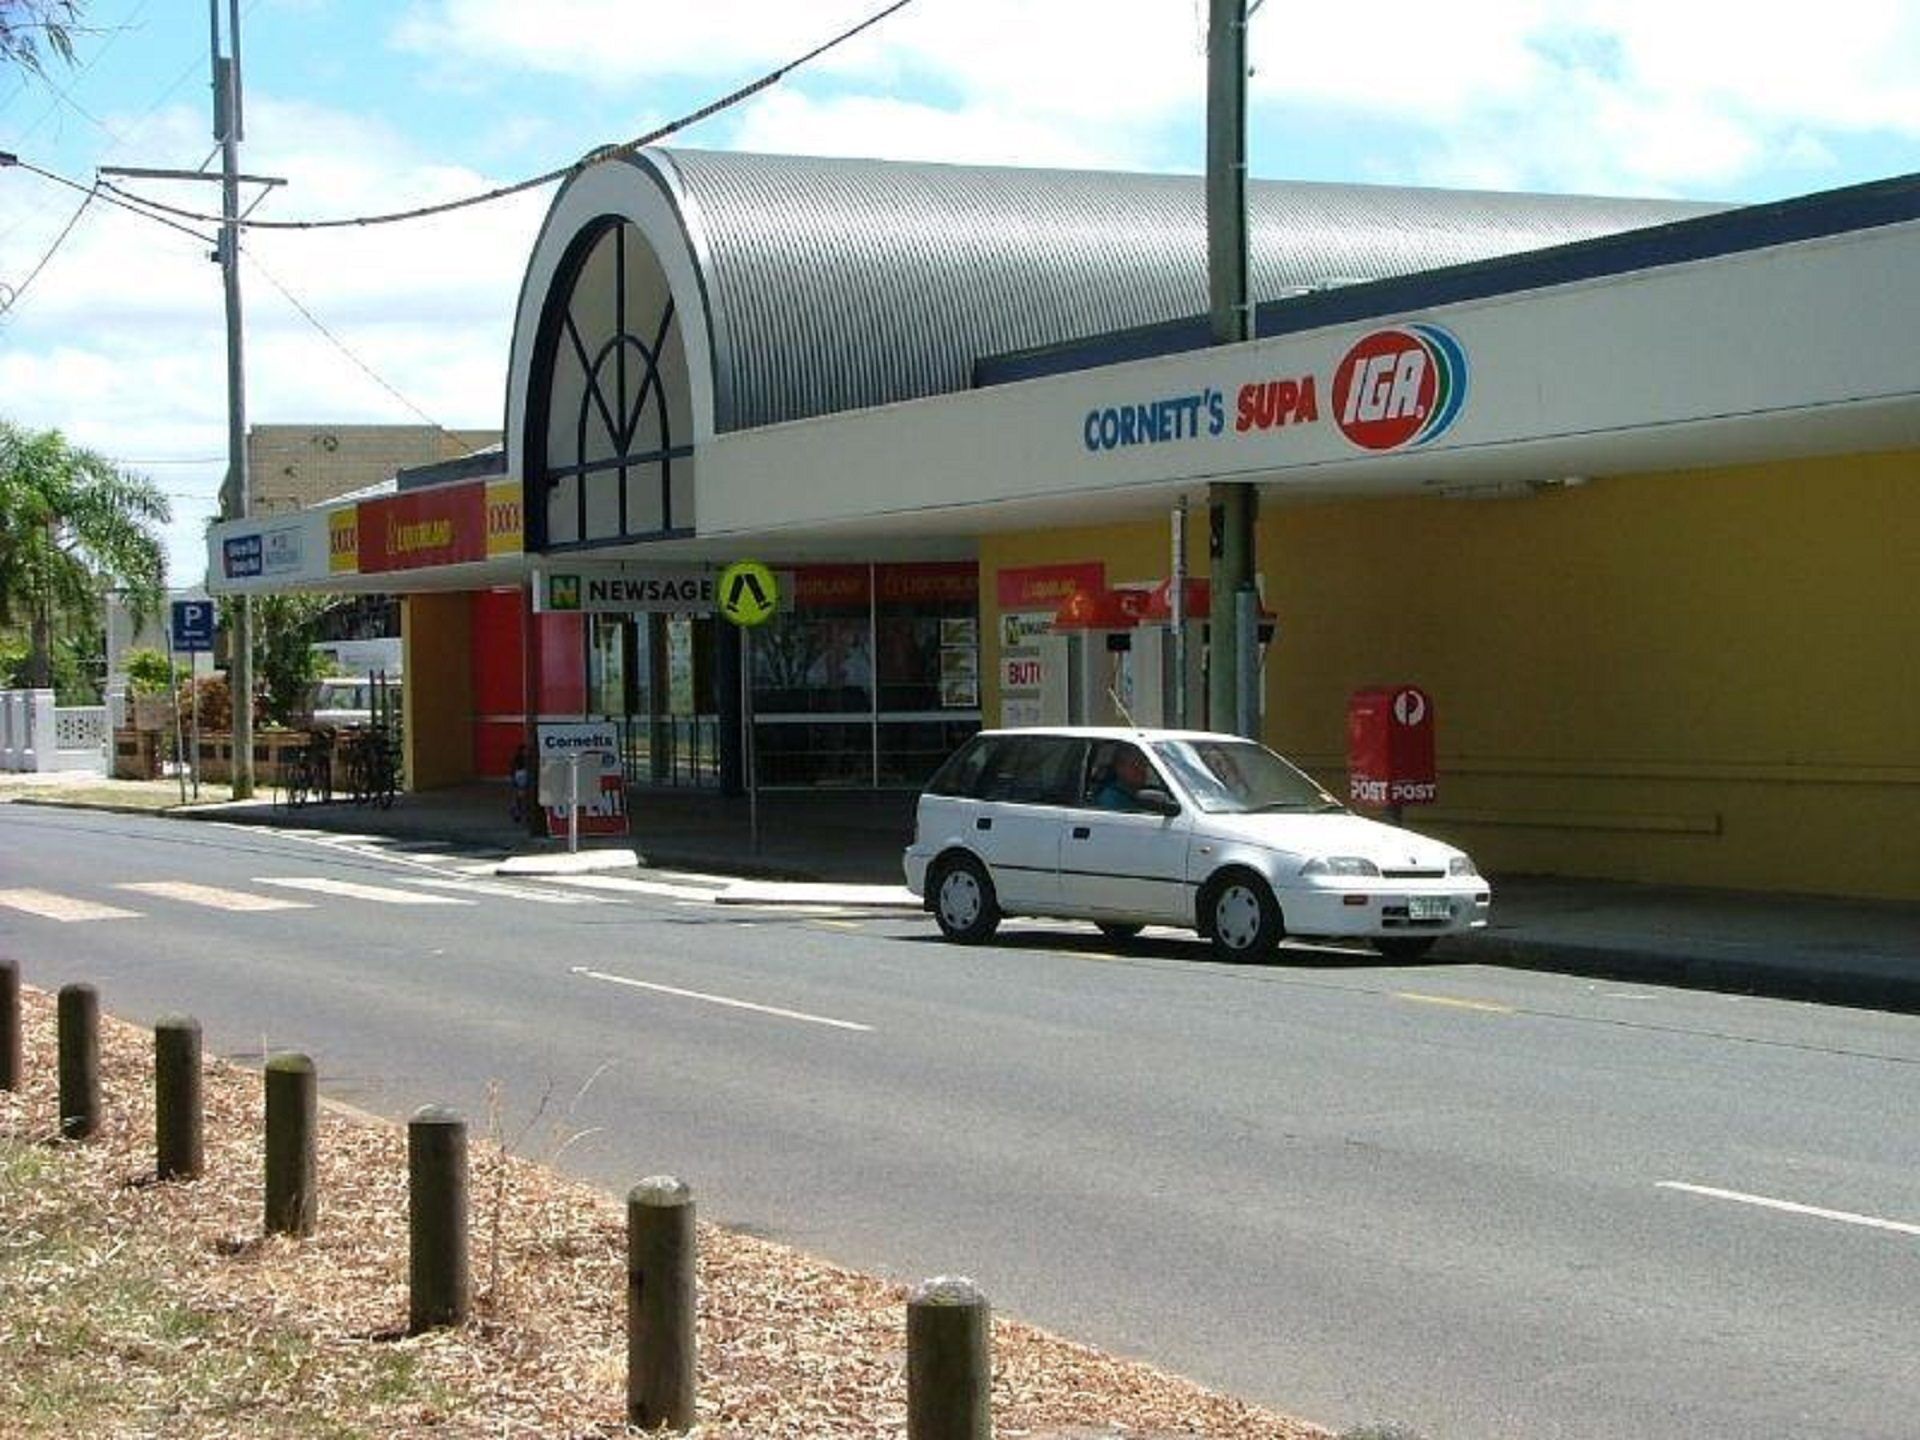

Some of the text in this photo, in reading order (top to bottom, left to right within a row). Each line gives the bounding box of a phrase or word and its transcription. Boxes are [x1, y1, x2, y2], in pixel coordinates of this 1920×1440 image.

[1342, 348, 1425, 425] IGA
[1084, 374, 1318, 451] CORNETT'S SUPA
[184, 605, 203, 628] P
[1008, 661, 1041, 685] BUT
[1350, 780, 1388, 801] POST
[1392, 784, 1436, 801] POST
